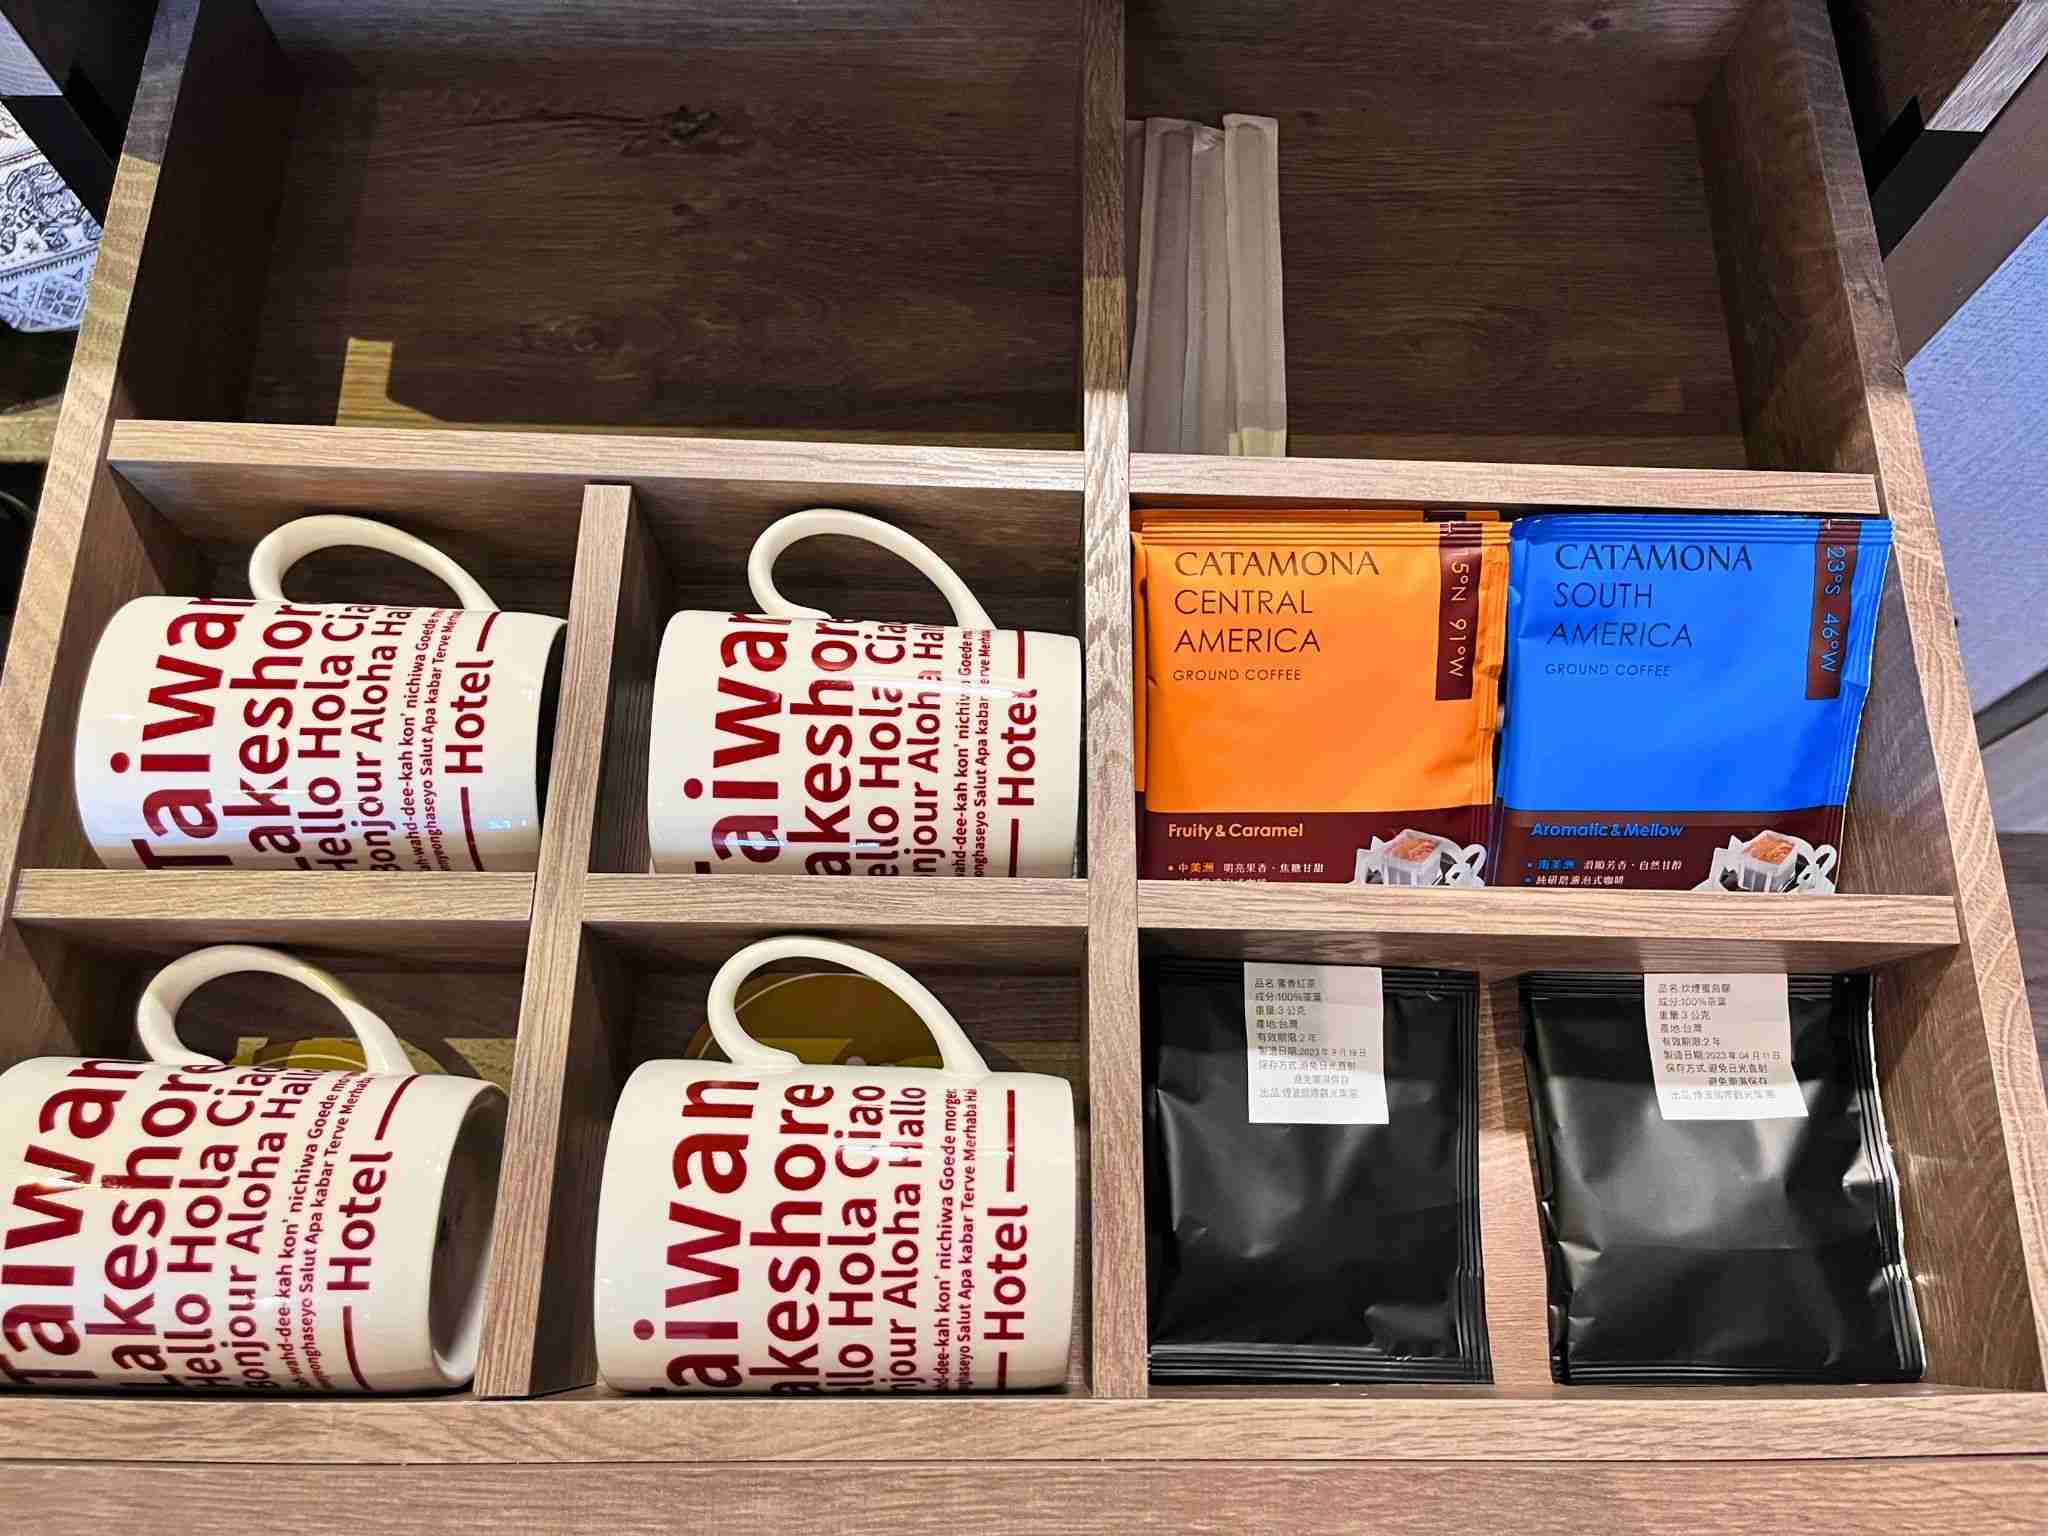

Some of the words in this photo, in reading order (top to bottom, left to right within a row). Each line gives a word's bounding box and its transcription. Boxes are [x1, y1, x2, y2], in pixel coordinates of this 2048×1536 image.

[1174, 551, 1380, 576] CATAMONA
[1555, 543, 1753, 572] CATAMONA
[1174, 589, 1313, 615] CENTRAL
[1553, 582, 1652, 609] SOUTH
[432, 635, 451, 663] Terve
[1173, 628, 1320, 653] AMERICA
[1546, 622, 1693, 648] AMERICA
[403, 654, 427, 708] nichiwa
[415, 619, 439, 650] Goede
[958, 641, 973, 676] Goede
[1173, 669, 1239, 681] GROUND
[1245, 668, 1302, 681] COFFEE
[1545, 663, 1609, 676] GROUND
[1615, 664, 1672, 677] COFFEE
[298, 656, 355, 758] Hola
[351, 646, 398, 742] Aloha
[424, 668, 443, 704] kabar
[422, 708, 439, 733] Apa
[444, 660, 494, 774] Hotel
[907, 671, 941, 773] Aloha
[976, 696, 989, 735] kabar
[419, 739, 433, 775] Salut
[976, 739, 991, 765] Apa
[975, 770, 987, 807] Salut
[324, 1117, 349, 1156] Terve
[833, 1086, 886, 1178] Ciao
[889, 1088, 926, 1168] Hallo
[961, 1104, 978, 1161] Merhaba
[289, 1143, 319, 1212] nichiwa
[307, 1094, 339, 1138] Goede
[938, 1136, 956, 1191] Goede
[225, 1132, 288, 1254] Aloha
[309, 1162, 335, 1207] kabar
[961, 1166, 976, 1211] Terve
[167, 1145, 239, 1272] Hola
[305, 1212, 323, 1244] Apa
[327, 1151, 392, 1291] Hotel
[633, 1079, 759, 1392] aiwan
[881, 1184, 921, 1308] Aloha
[937, 1197, 954, 1269] nichiwa
[959, 1216, 974, 1264] kabar
[298, 1249, 317, 1292] Salut
[827, 1198, 877, 1325] Hola
[959, 1269, 974, 1299] Apa
[983, 1205, 1028, 1341] Hotel
[222, 1264, 281, 1388] Bonjour
[957, 1304, 972, 1342] Salut
